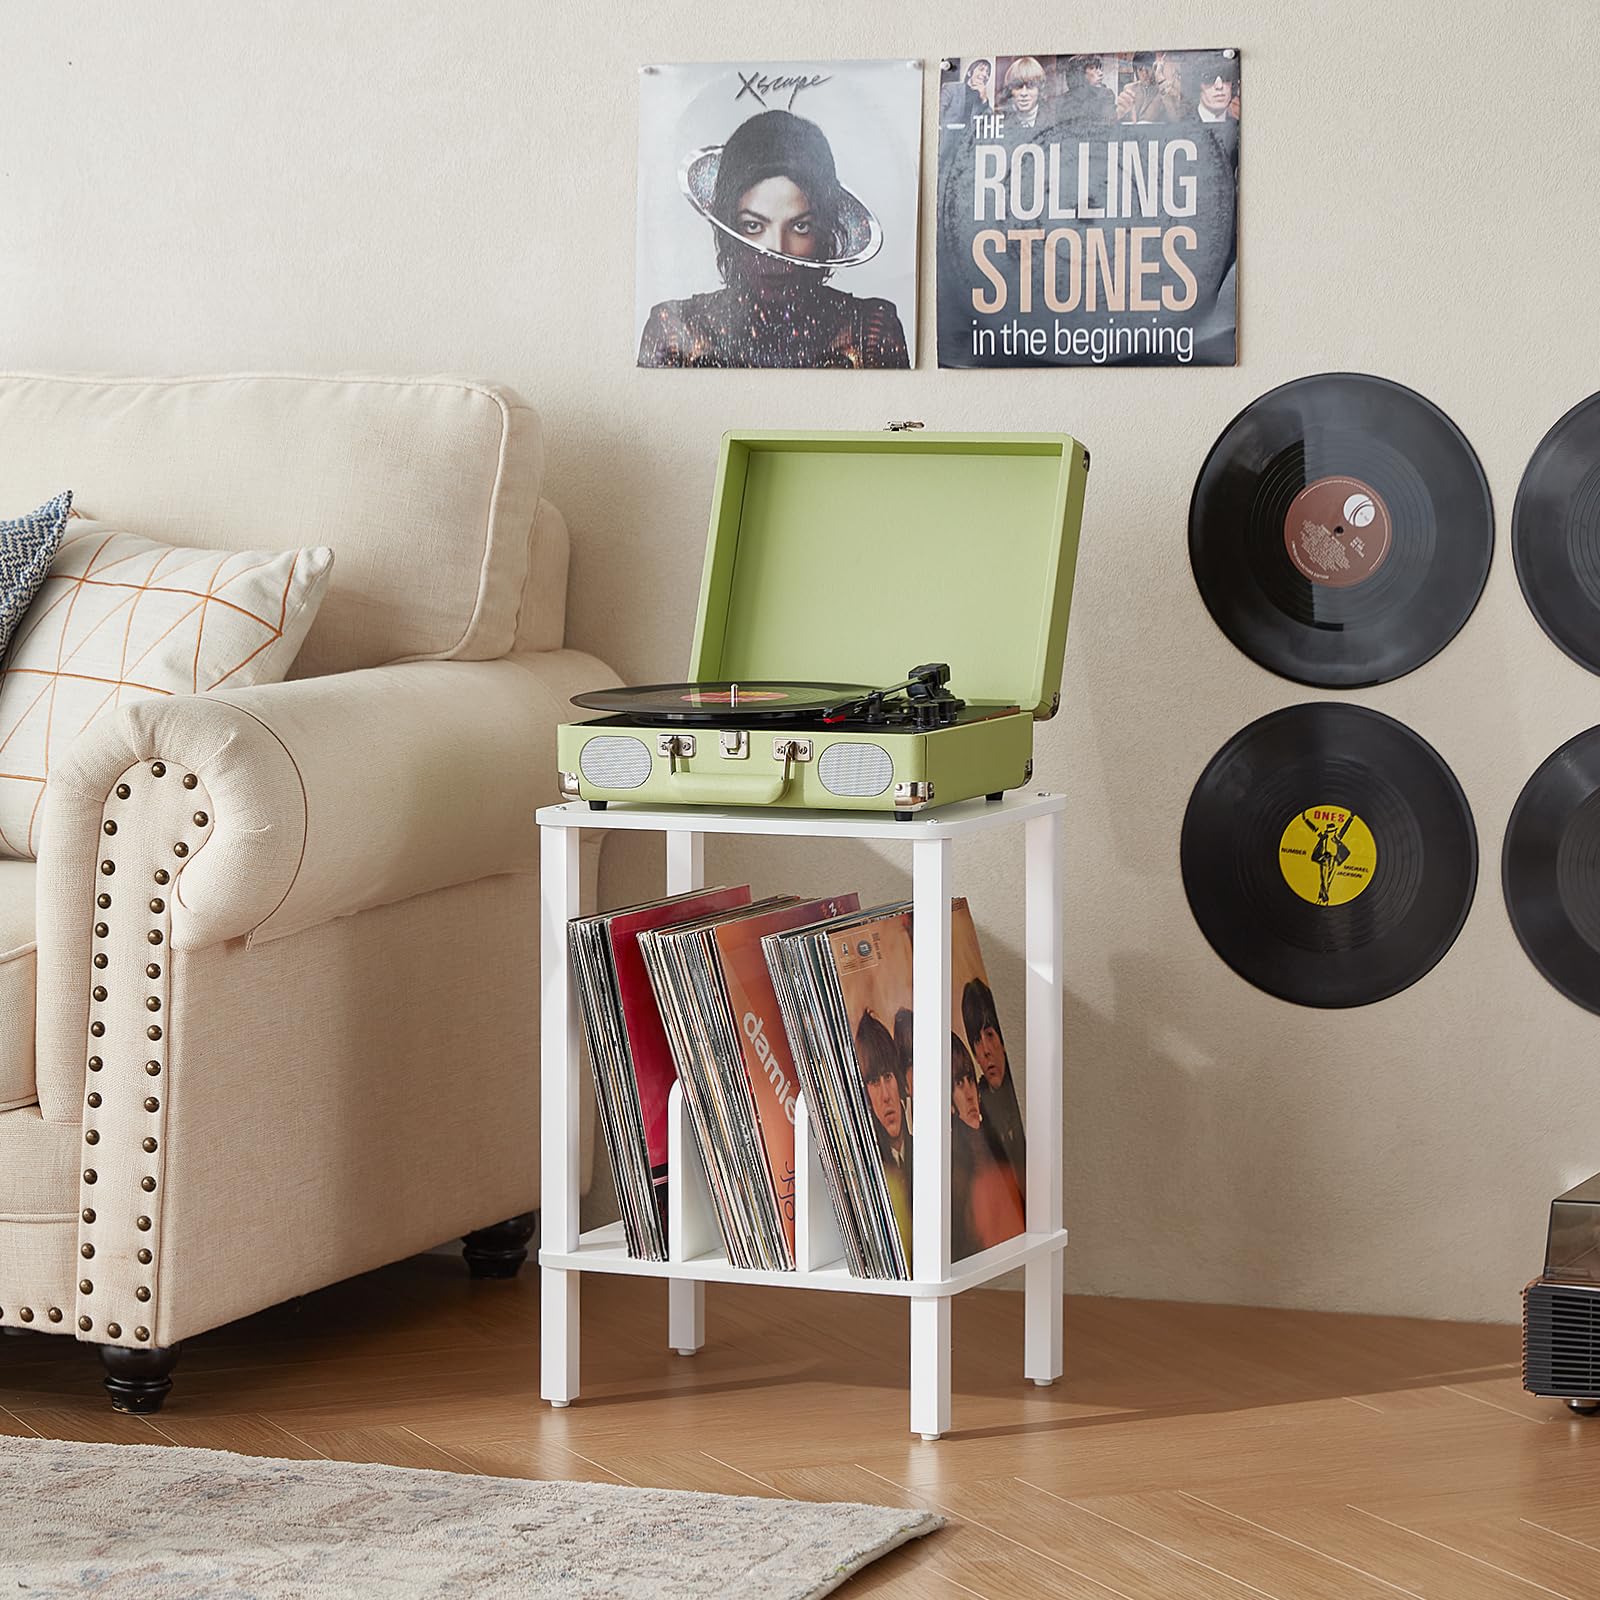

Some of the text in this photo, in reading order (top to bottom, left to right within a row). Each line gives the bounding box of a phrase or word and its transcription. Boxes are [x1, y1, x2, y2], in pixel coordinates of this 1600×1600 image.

[735, 71, 833, 111] Xscape
[973, 114, 1005, 139] THE
[974, 139, 1198, 221] ROLLING
[972, 226, 1198, 314] STONES
[972, 318, 1195, 363] in the beginning
[1314, 811, 1345, 822] ONES
[1281, 847, 1307, 856] NUMBER
